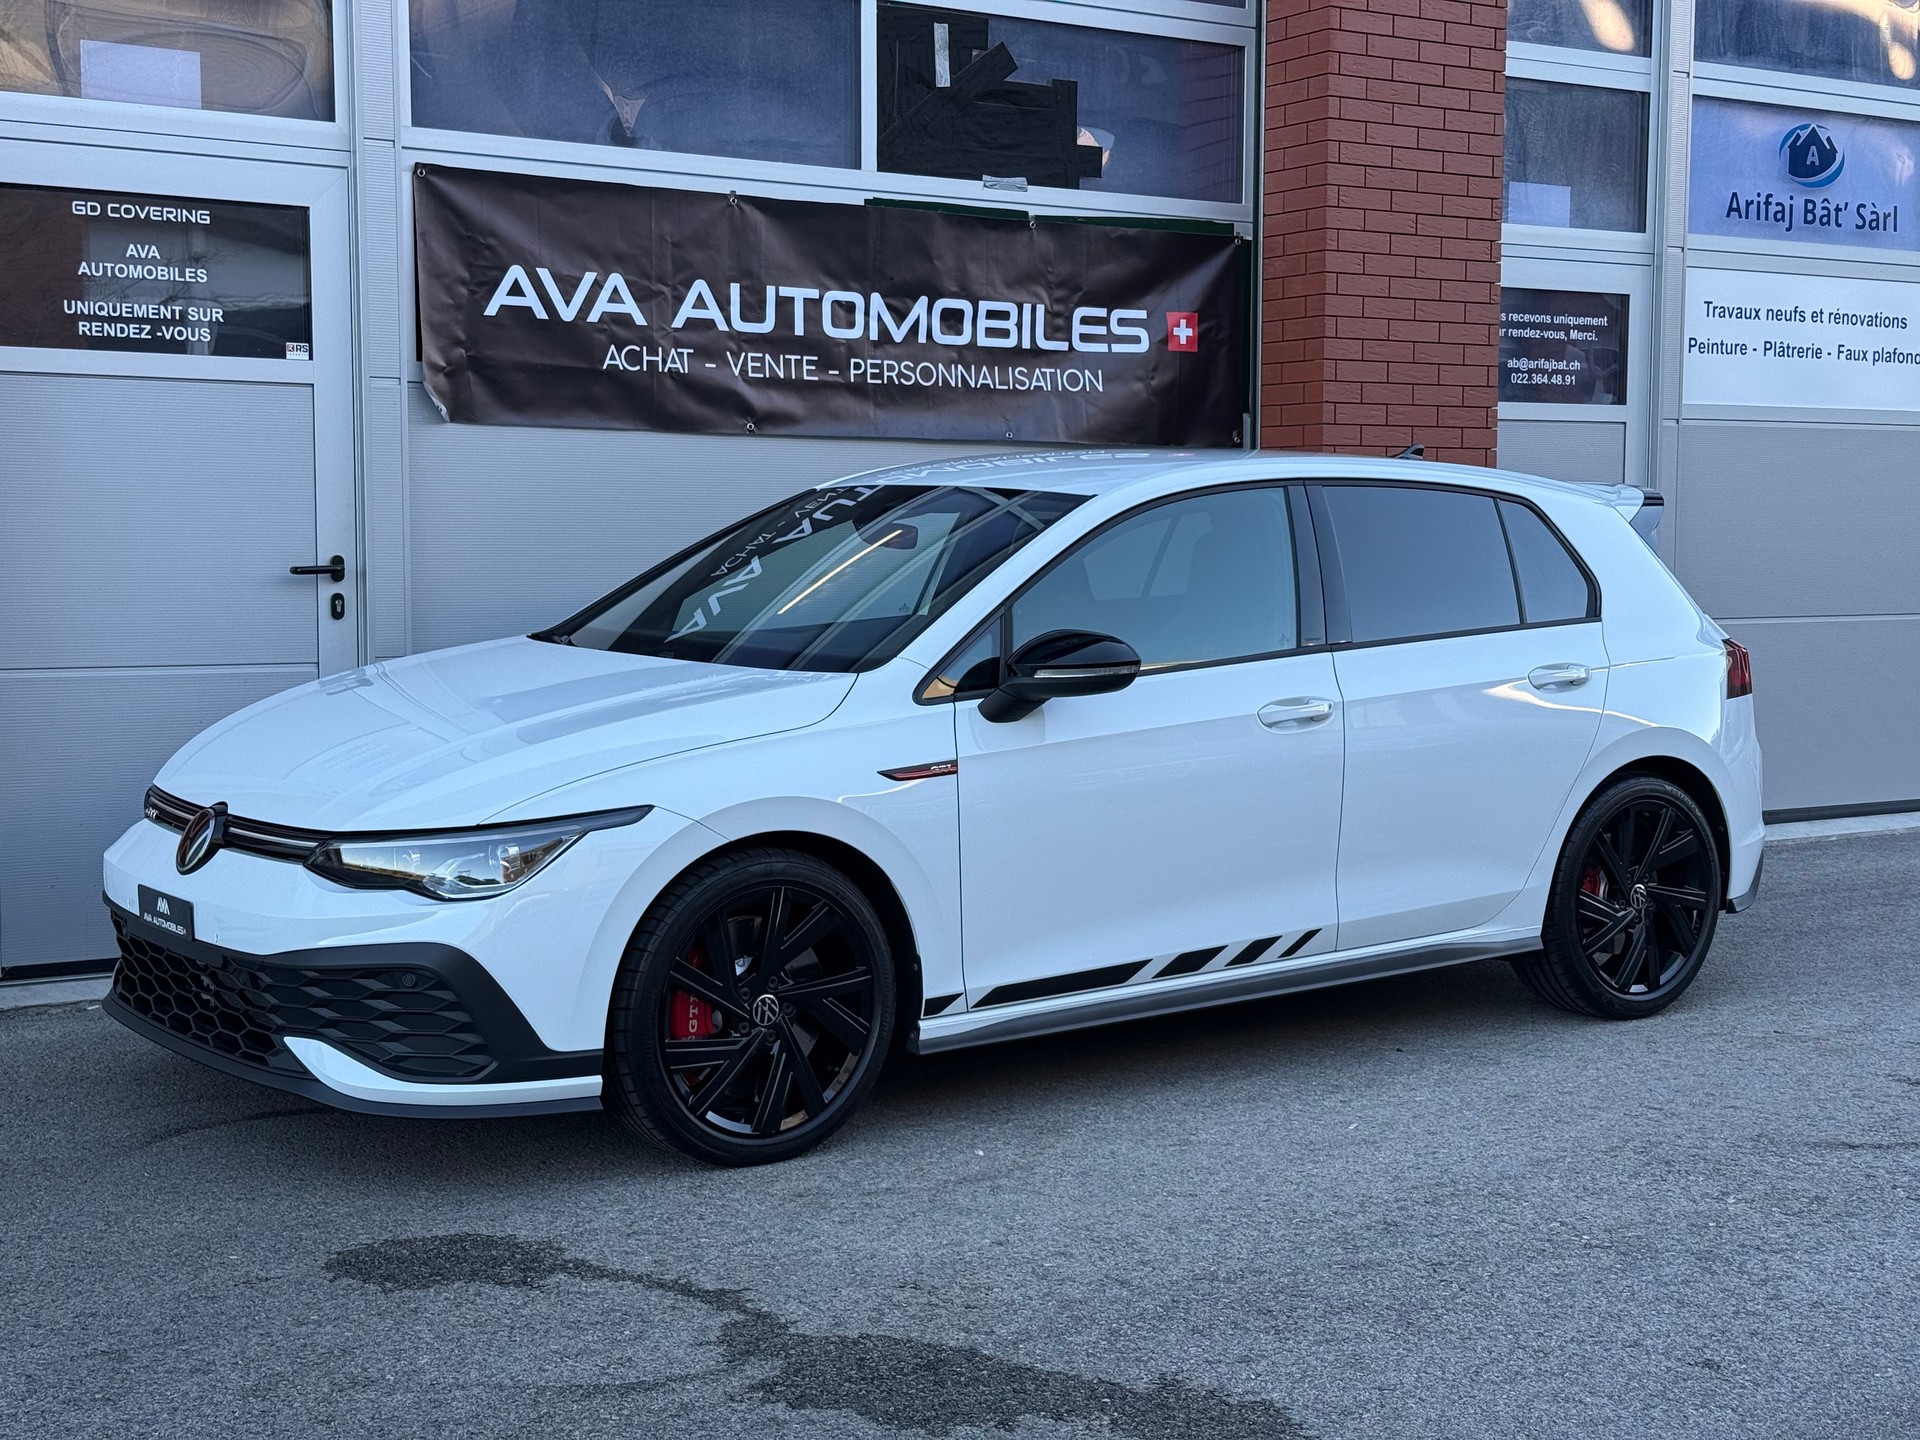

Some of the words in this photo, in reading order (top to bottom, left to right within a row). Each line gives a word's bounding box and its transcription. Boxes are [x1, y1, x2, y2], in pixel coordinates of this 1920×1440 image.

[71, 201, 101, 216] GD
[107, 203, 211, 224] COVERING
[1725, 191, 1794, 232] Arifaj
[1855, 202, 1898, 232] Sàrl
[125, 243, 161, 260] AVA
[77, 261, 208, 283] AUTOMOBILES
[63, 299, 183, 321] UNIQUEMENT
[187, 307, 224, 323] SUR
[483, 264, 648, 326] AVA
[670, 279, 1150, 353] AUTOMOBILES
[1508, 312, 1551, 323] recevons
[1553, 313, 1608, 327] uniquement
[1703, 300, 1762, 321] Travaux
[1766, 305, 1806, 323] neufs
[1811, 307, 1825, 324] et
[1828, 307, 1908, 330] rénovations
[78, 321, 152, 339] RENDEZ
[1508, 327, 1568, 341] rendez-vous,
[1569, 329, 1598, 341] Merci.
[1688, 337, 1748, 356] Peinture
[1763, 340, 1823, 360] Plâtrerie
[1837, 344, 1868, 362] Faux
[602, 344, 695, 374] ACHAT
[726, 351, 819, 381] VENTE
[850, 358, 1104, 392] PERSONNALISATION
[1507, 357, 1581, 372] ab@arifajbat.ch
[1510, 373, 1576, 385] 022.364.48.91
